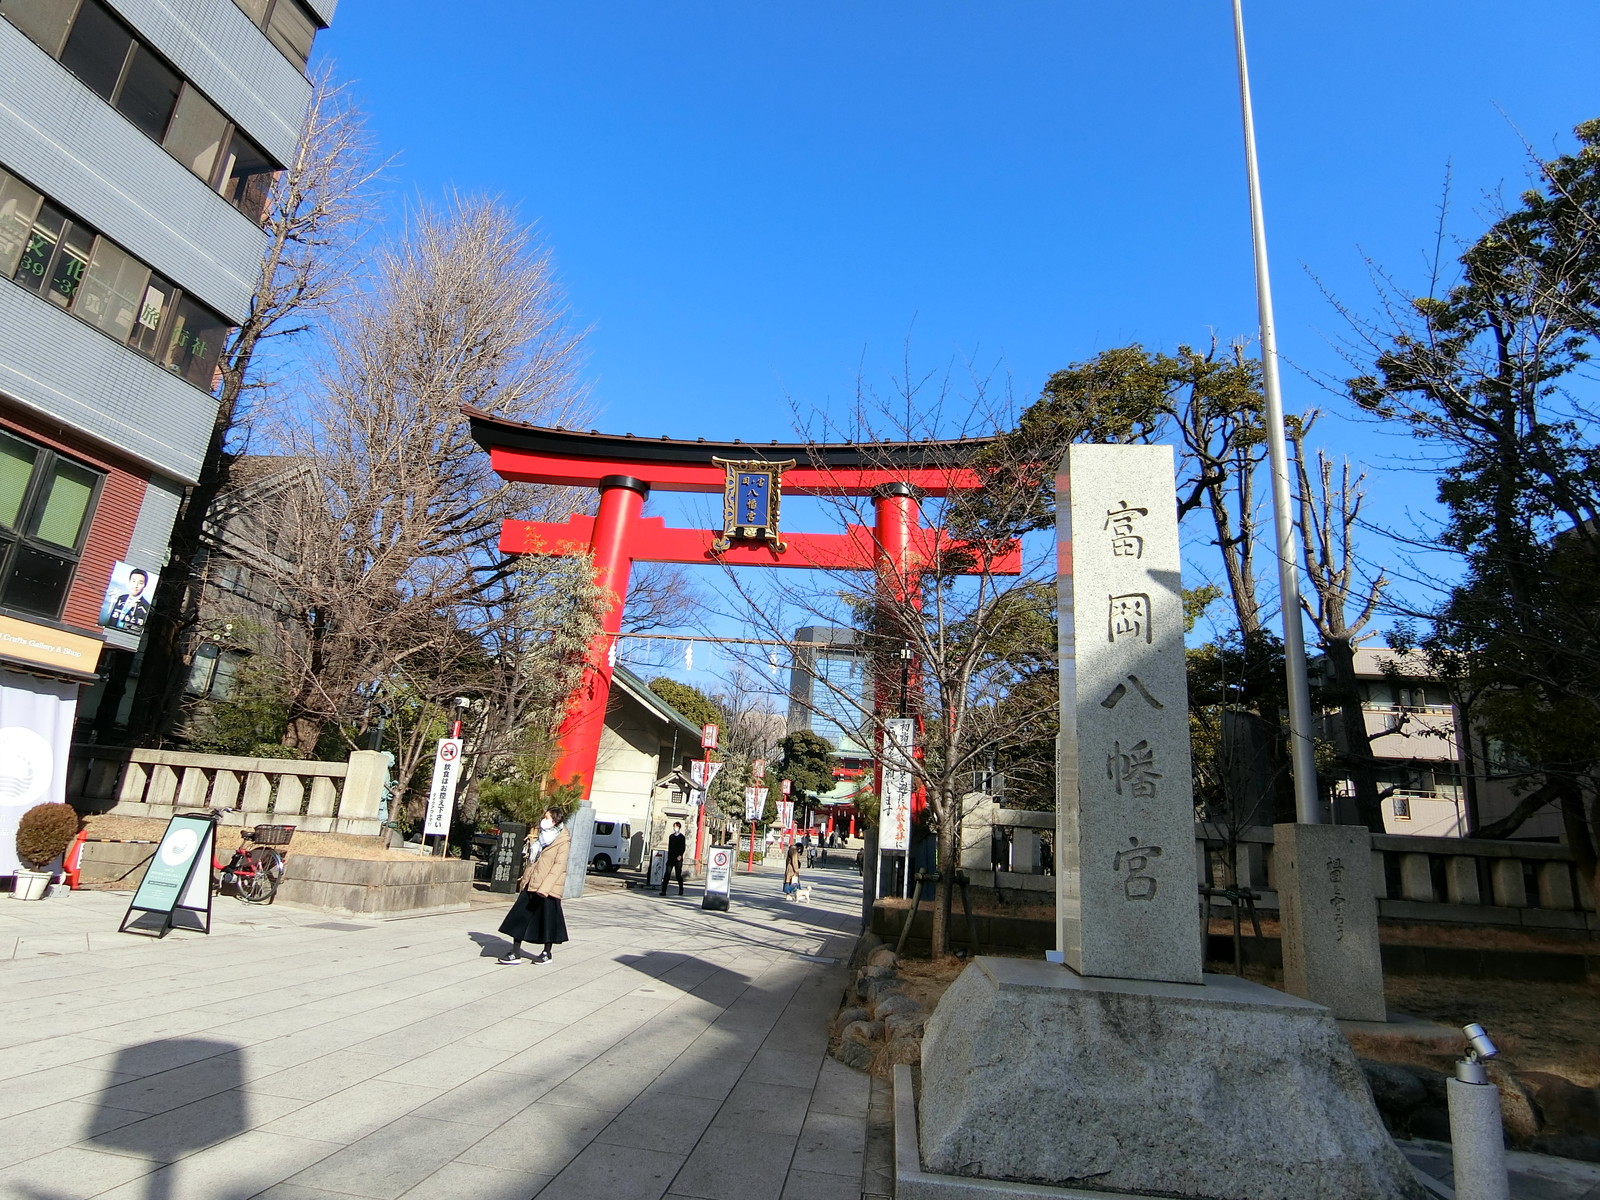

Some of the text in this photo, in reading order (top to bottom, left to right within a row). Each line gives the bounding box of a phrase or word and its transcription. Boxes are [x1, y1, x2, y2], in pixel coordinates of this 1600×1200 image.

[3, 633, 27, 645] Crafts
[28, 639, 55, 652] Gallery
[63, 647, 82, 658] Shop
[1101, 500, 1163, 901] 富岡八幡宮
[434, 763, 451, 828] 飲食はお控え下さい
